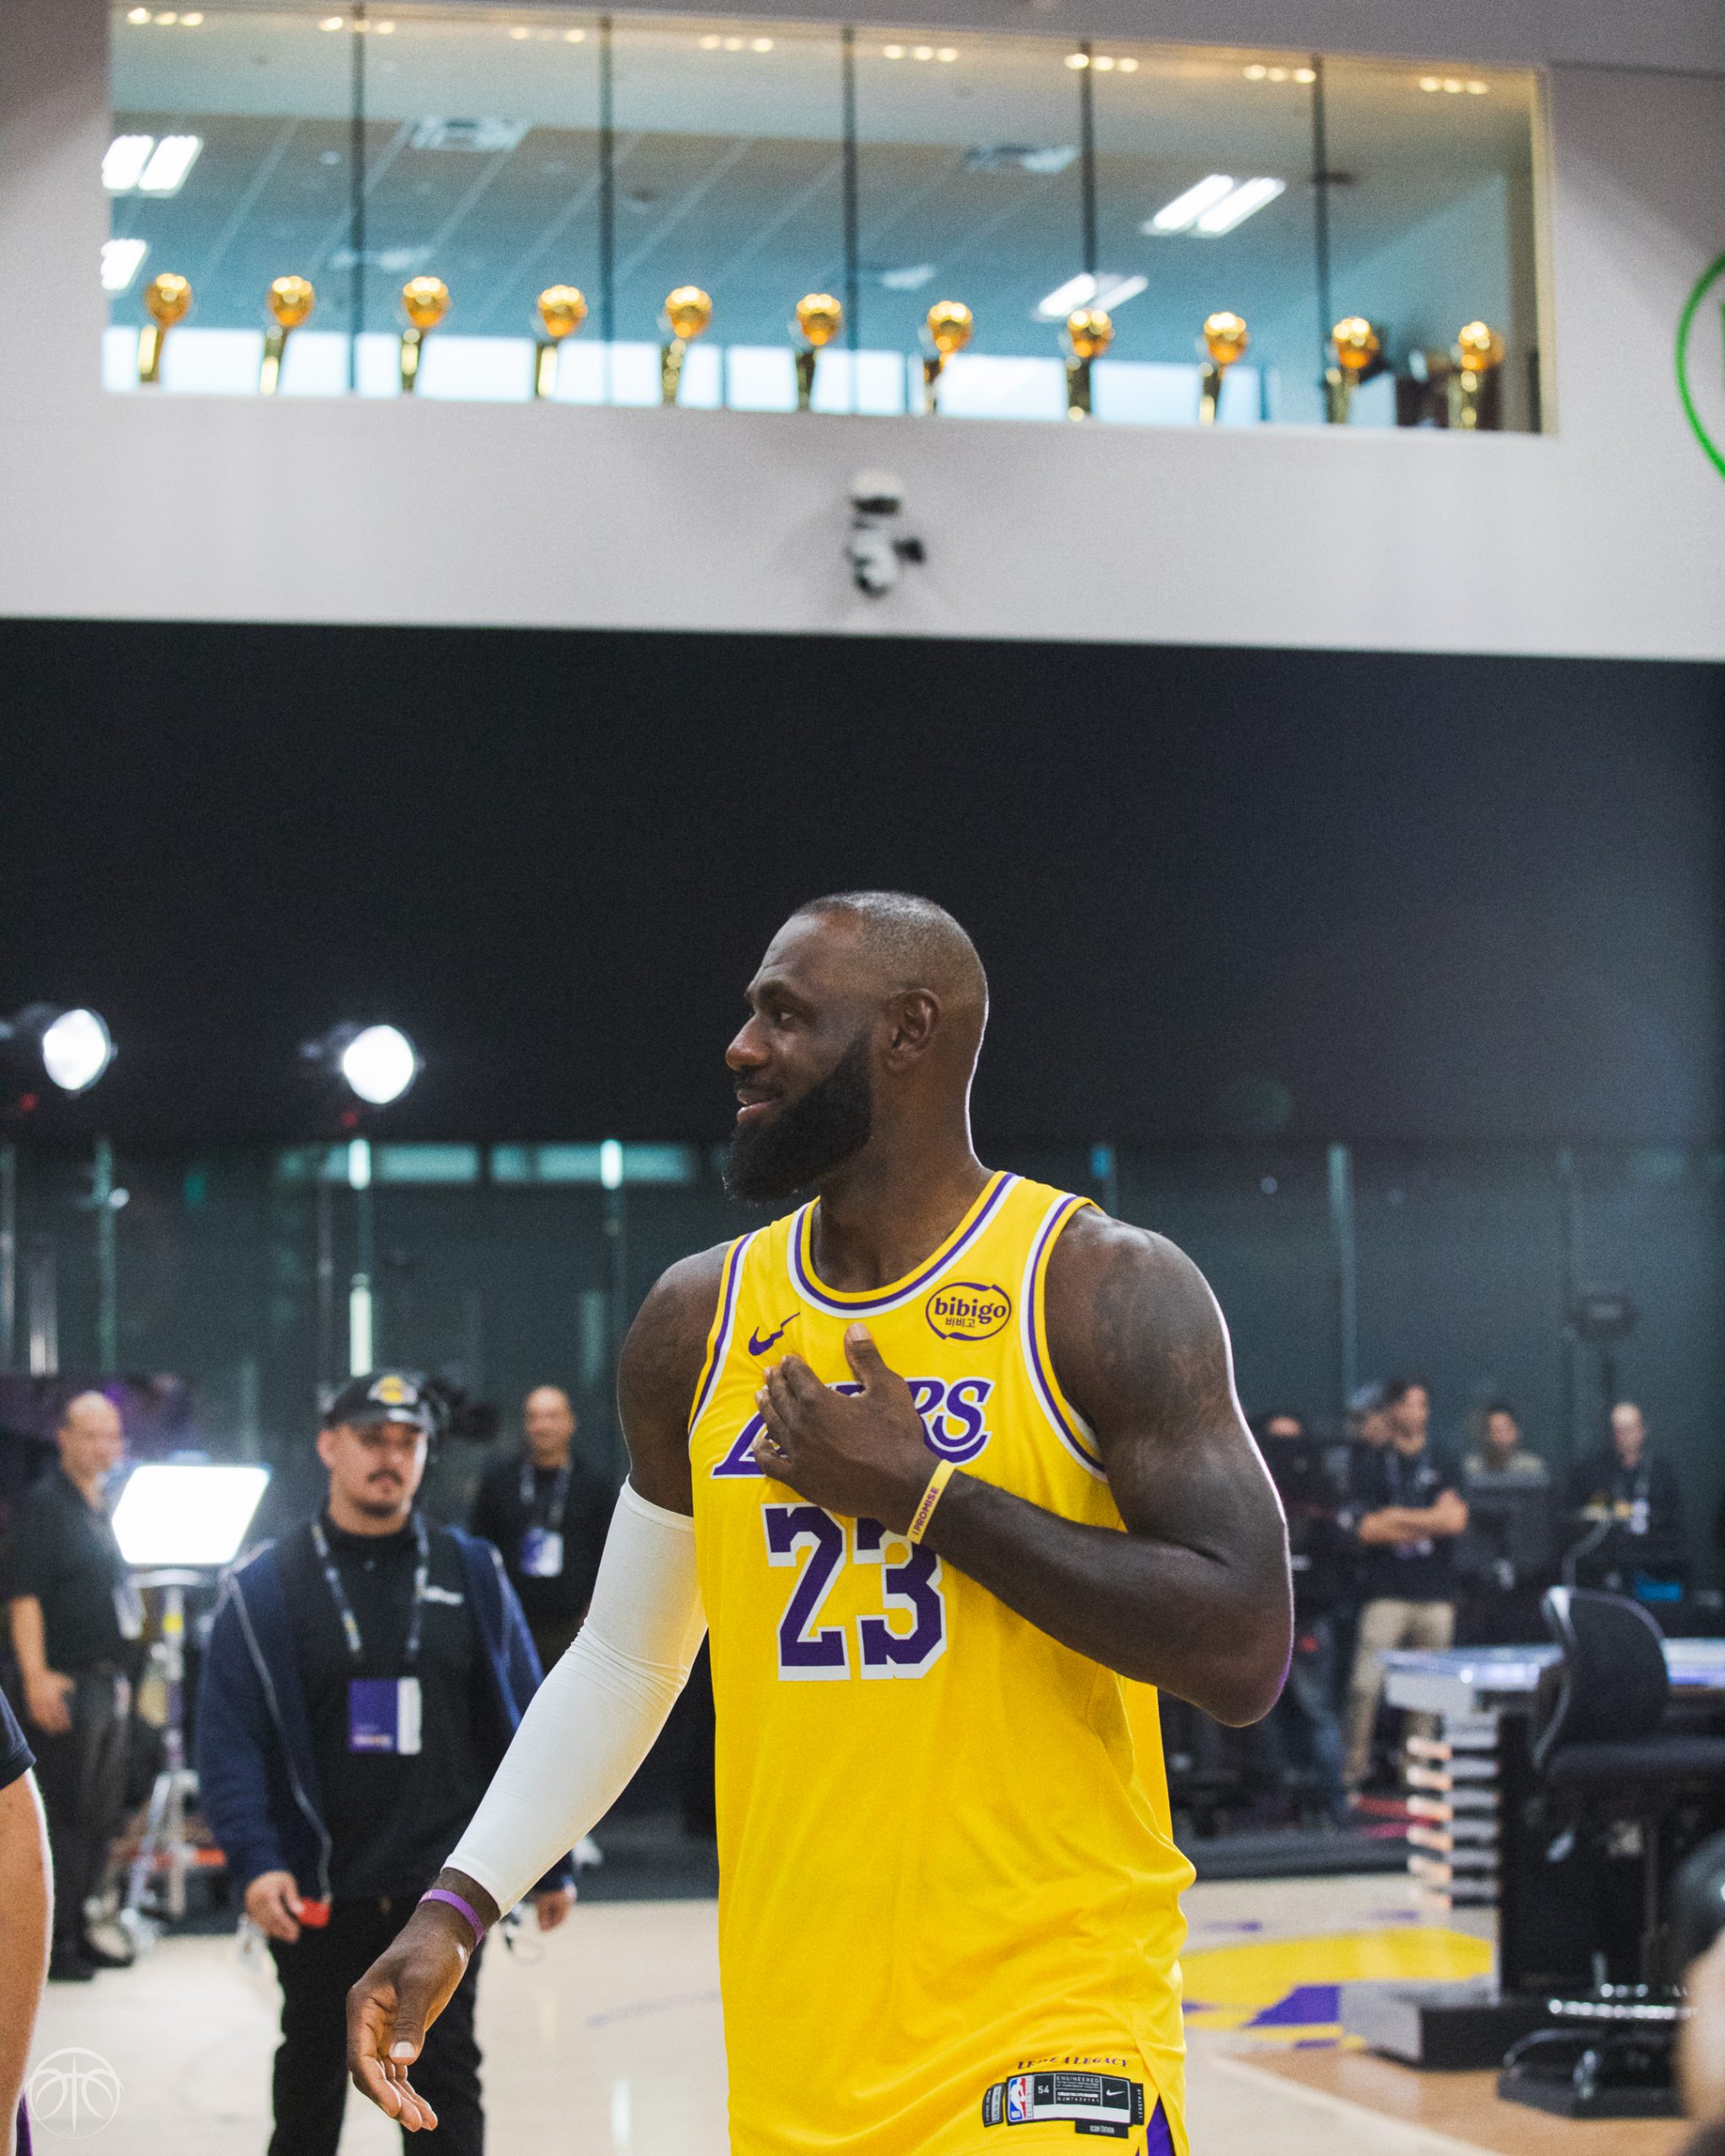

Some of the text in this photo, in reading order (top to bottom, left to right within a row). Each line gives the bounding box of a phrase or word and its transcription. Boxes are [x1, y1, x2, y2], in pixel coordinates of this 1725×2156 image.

[934, 1296, 1007, 1325] bibigo
[945, 1316, 976, 1328] 비비고
[914, 1486, 939, 1532] PROMISE
[761, 1502, 948, 1681] 23
[1056, 2075, 1099, 2084] ENGINEERED
[1038, 2085, 1050, 2095] 54
